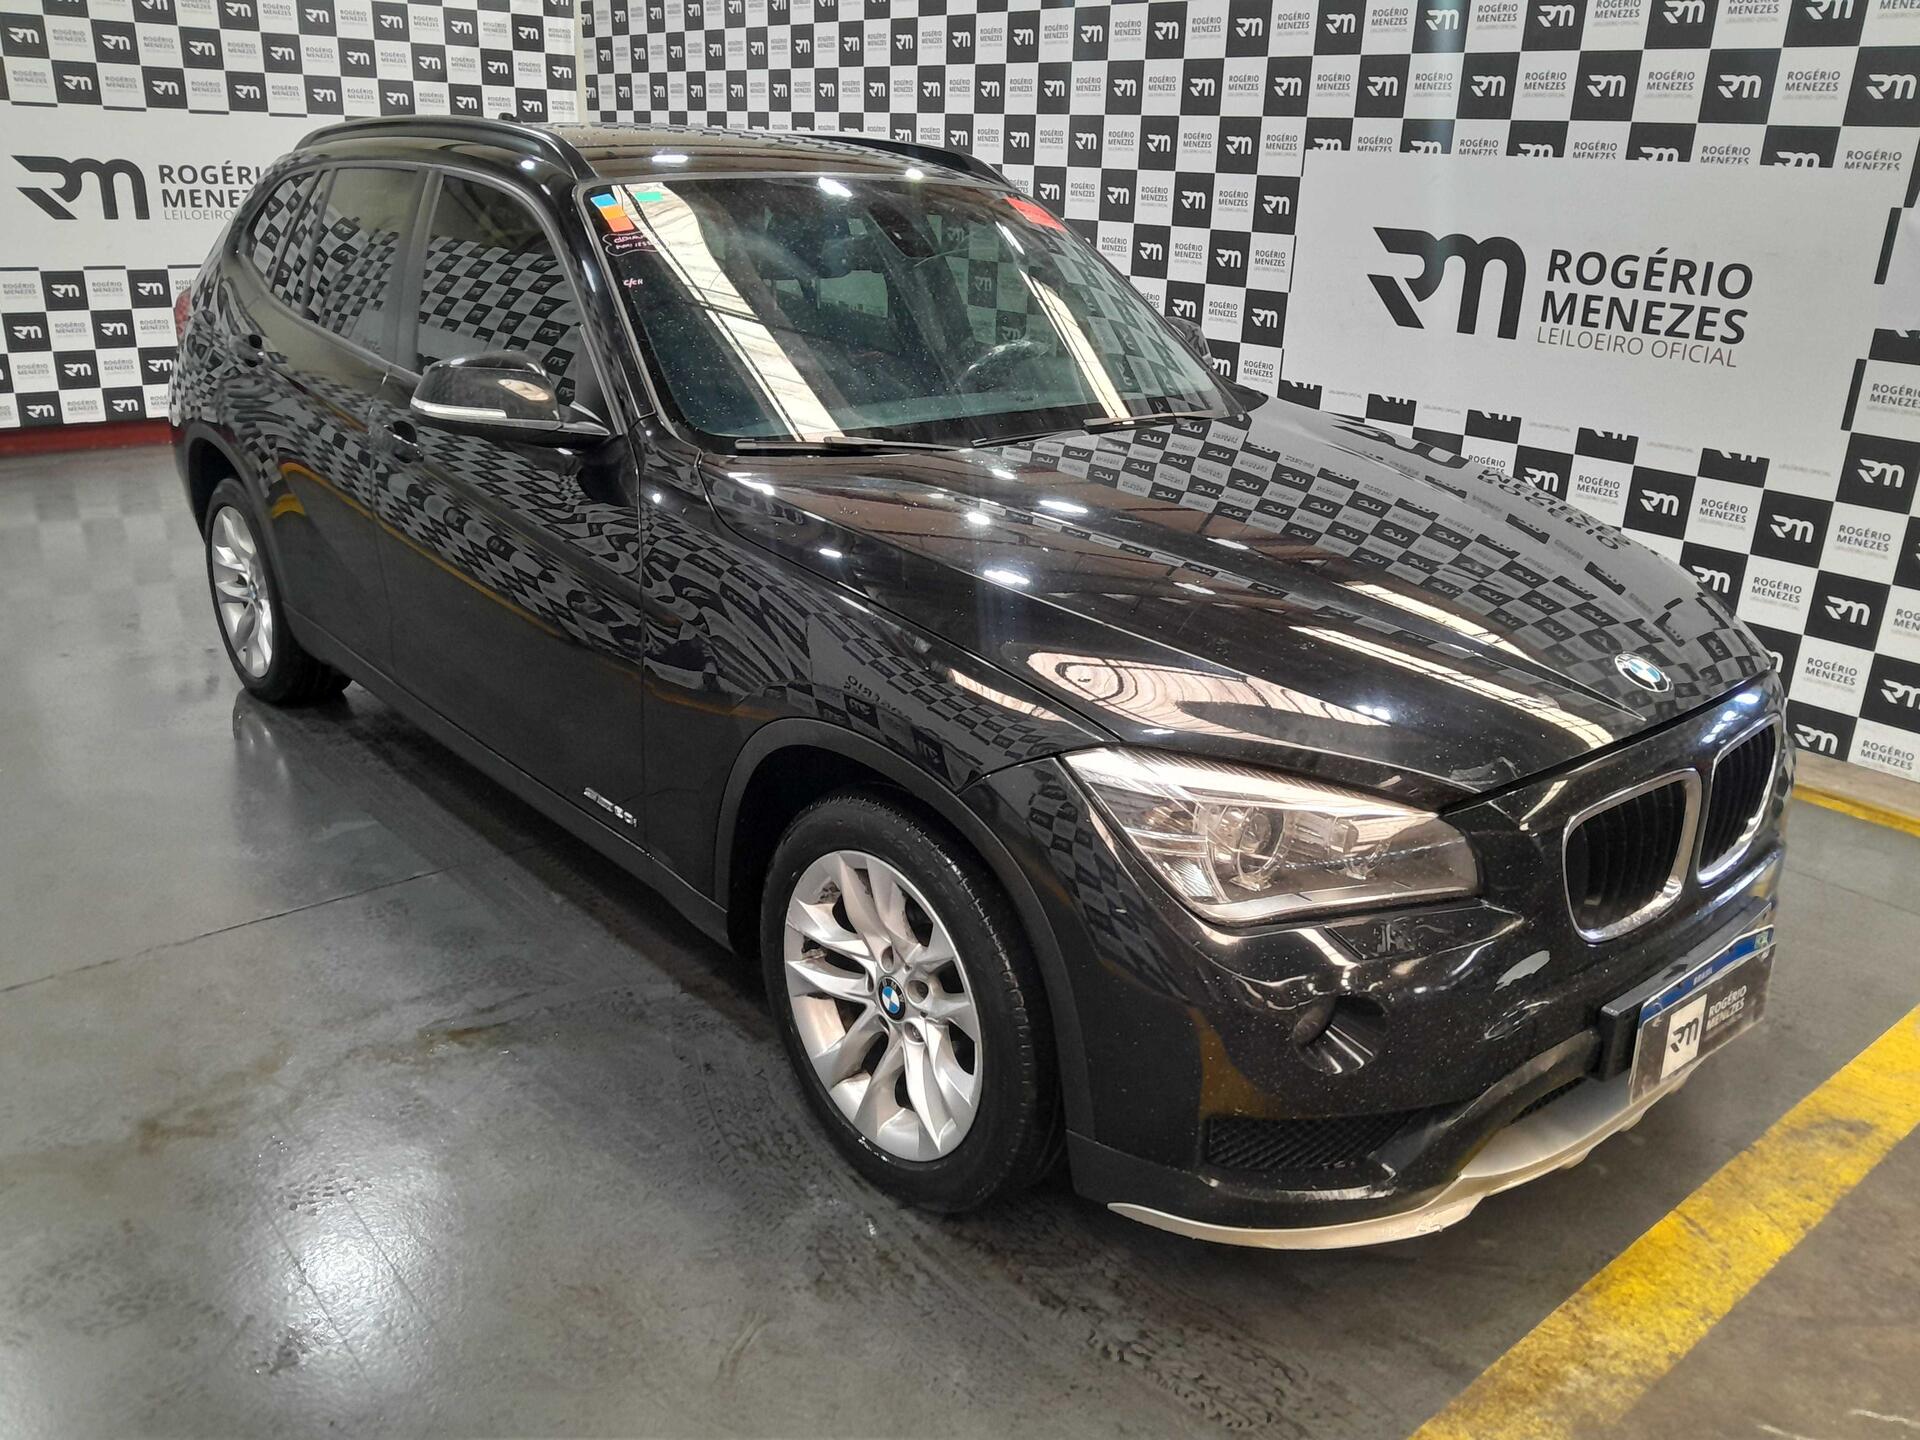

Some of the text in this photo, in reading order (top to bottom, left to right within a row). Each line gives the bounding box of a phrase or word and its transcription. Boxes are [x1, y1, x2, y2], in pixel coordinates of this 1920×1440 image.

[1372, 7, 1409, 17] ROGÉRIO
[1477, 2, 1519, 13] ROGÉRIO
[1727, 3, 1781, 14] MENEZES
[1277, 11, 1310, 21] ROGÉRIO
[1476, 13, 1518, 23] MENEZES
[1593, 8, 1641, 19] MENEZES
[1192, 15, 1222, 25] ROGÉRIO
[1276, 21, 1310, 30] MENEZES
[1370, 17, 1408, 26] MENEZES
[1191, 25, 1222, 33] MENEZES
[1228, 74, 1260, 83] ROGÉRIO
[1317, 73, 1351, 82] ROGÉRIO
[1414, 72, 1453, 81] ROGÉRIO
[1524, 70, 1567, 81] ROGÉRIO
[1647, 69, 1696, 80] ROGÉRIO
[1786, 68, 1842, 80] ROGÉRIO
[1228, 83, 1259, 91] MENEZES
[1413, 82, 1452, 90] MENEZES
[1522, 82, 1566, 90] MENEZES
[1645, 82, 1695, 91] MENEZES
[1784, 81, 1841, 91] MENEZES
[1266, 133, 1298, 143] ROGÉRIO
[1357, 136, 1393, 145] ROGÉRIO
[1459, 138, 1499, 148] ROGÉRIO
[1265, 143, 1298, 151] MENEZES
[1572, 141, 1617, 152] ROGÉRIO
[1700, 144, 1751, 156] ROGÉRIO
[1846, 148, 1904, 161] ROGÉRIO
[158, 160, 261, 185] ROGÉRI
[1219, 190, 1249, 199] ROGÉRIO
[1218, 198, 1248, 207] MENEZES
[1255, 249, 1286, 259] ROGÉRIO
[1254, 257, 1286, 267] MENEZES
[1547, 247, 1753, 299] ROGÉRIO
[1208, 307, 1238, 318] MENEZES
[1540, 291, 1749, 345] MENEZES
[1537, 327, 1737, 368] LEILOEIRO OFICIAL
[1244, 359, 1275, 370] ROGÉRIO
[1244, 367, 1274, 378] MENEZES
[1871, 382, 1920, 399] ROGÉRI
[1869, 393, 1920, 409] MENEZE
[1577, 474, 1620, 490] ROGÉRIO
[1575, 483, 1619, 499] MENEZES
[1699, 497, 1748, 514] ROGÉRIO
[1697, 507, 1747, 524] MENEZES
[1838, 524, 1893, 542] ROGÉRIO
[1835, 533, 1892, 552] MENEZES
[1752, 576, 1803, 594] ROGÉRIO
[1750, 585, 1801, 603] MENEZES
[1806, 656, 1859, 677] ROGÉRIO
[1804, 665, 1858, 686] MENEZES
[1862, 739, 1918, 762] ROGÉRIO
[1860, 748, 1916, 771] MENEZES
[1708, 985, 1747, 1016] ROGÉRIO
